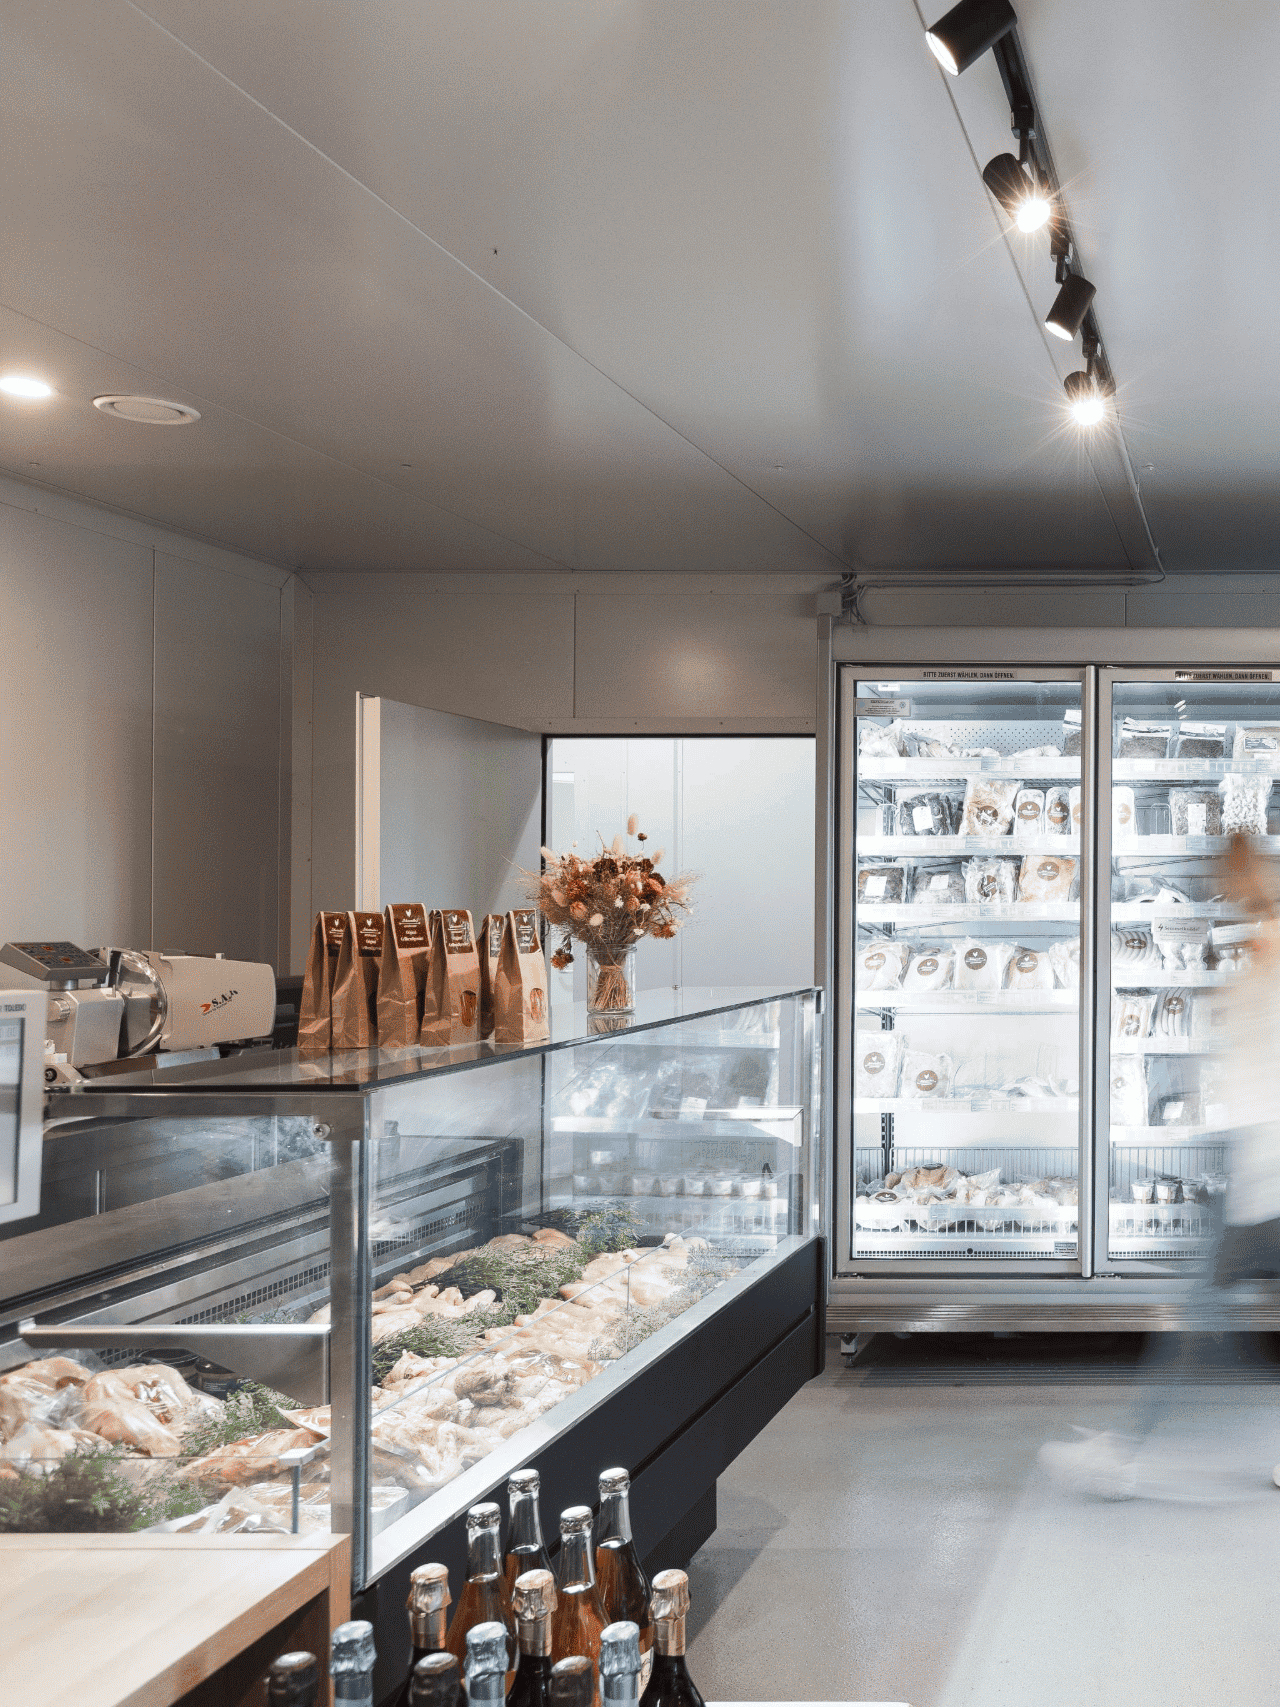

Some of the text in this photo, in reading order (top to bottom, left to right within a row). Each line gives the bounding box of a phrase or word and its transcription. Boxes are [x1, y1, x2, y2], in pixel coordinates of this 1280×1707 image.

[957, 671, 978, 679] WÄHLEN,
[994, 671, 1015, 679] ÖFFNEN.
[1193, 672, 1212, 680] ZUERST
[1234, 672, 1248, 680] DANN
[1249, 671, 1270, 680] ÖFFNEN.
